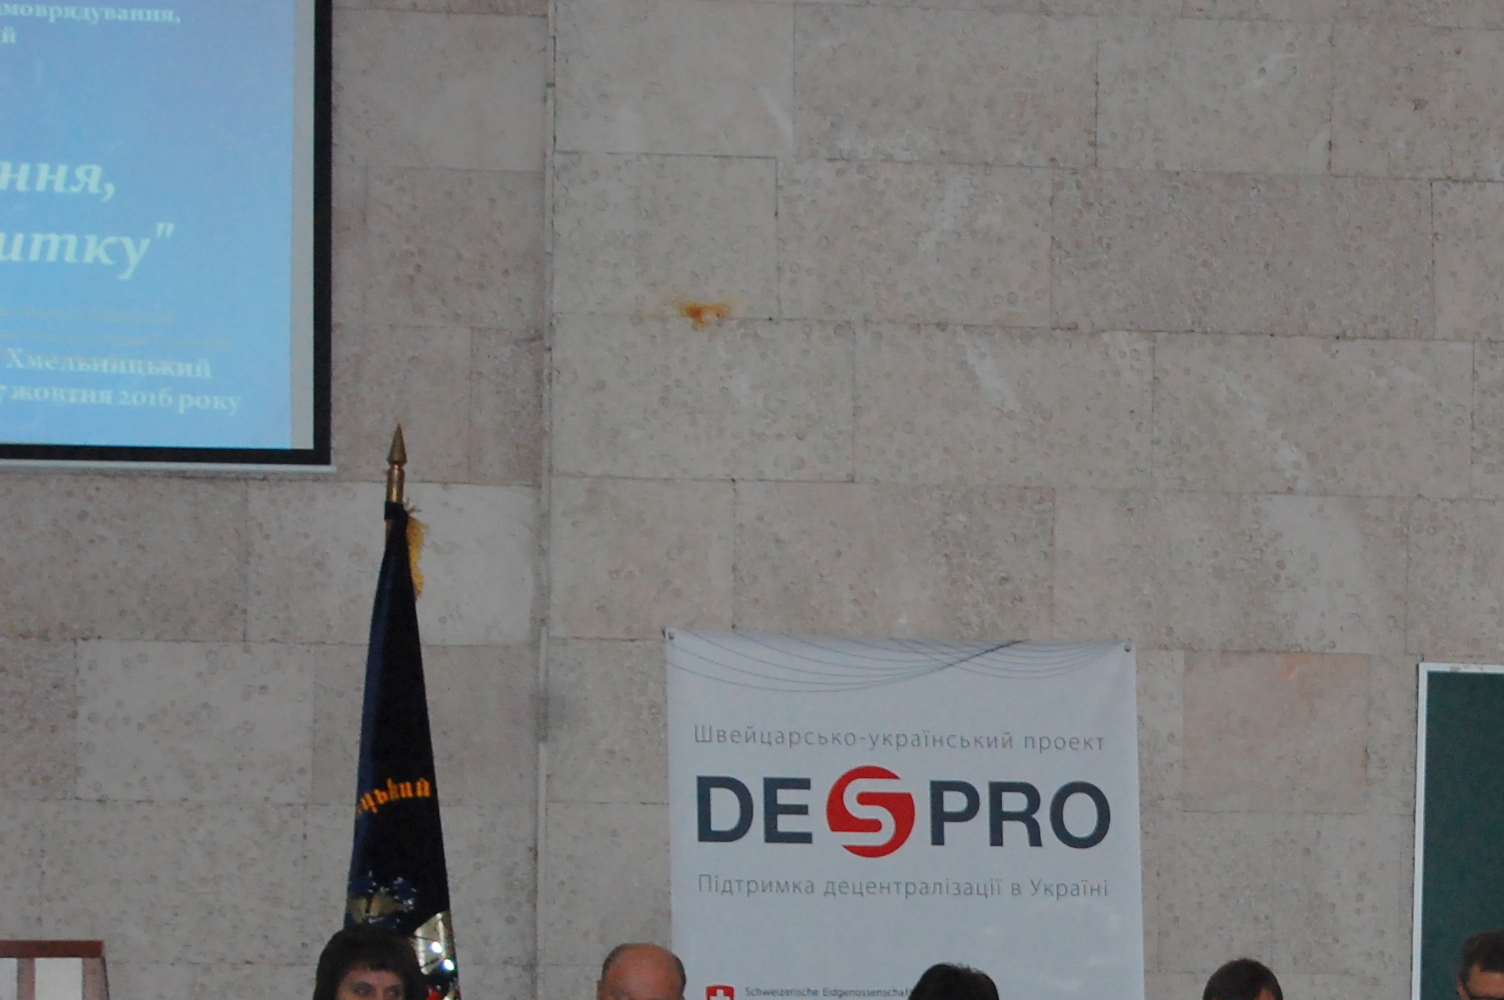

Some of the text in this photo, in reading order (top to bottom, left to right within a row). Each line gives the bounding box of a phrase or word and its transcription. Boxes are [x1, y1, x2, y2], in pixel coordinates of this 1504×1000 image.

[5, 347, 212, 378] Хмельницький
[11, 385, 113, 404] жовтня
[118, 386, 174, 407] 2016
[178, 393, 242, 416] року
[694, 724, 1105, 753] Швейцарсько-український проект
[695, 765, 1111, 858] DESPRO
[697, 872, 1109, 901] Підтримка децентралізації в Україні
[744, 986, 819, 997] Schweizerische
